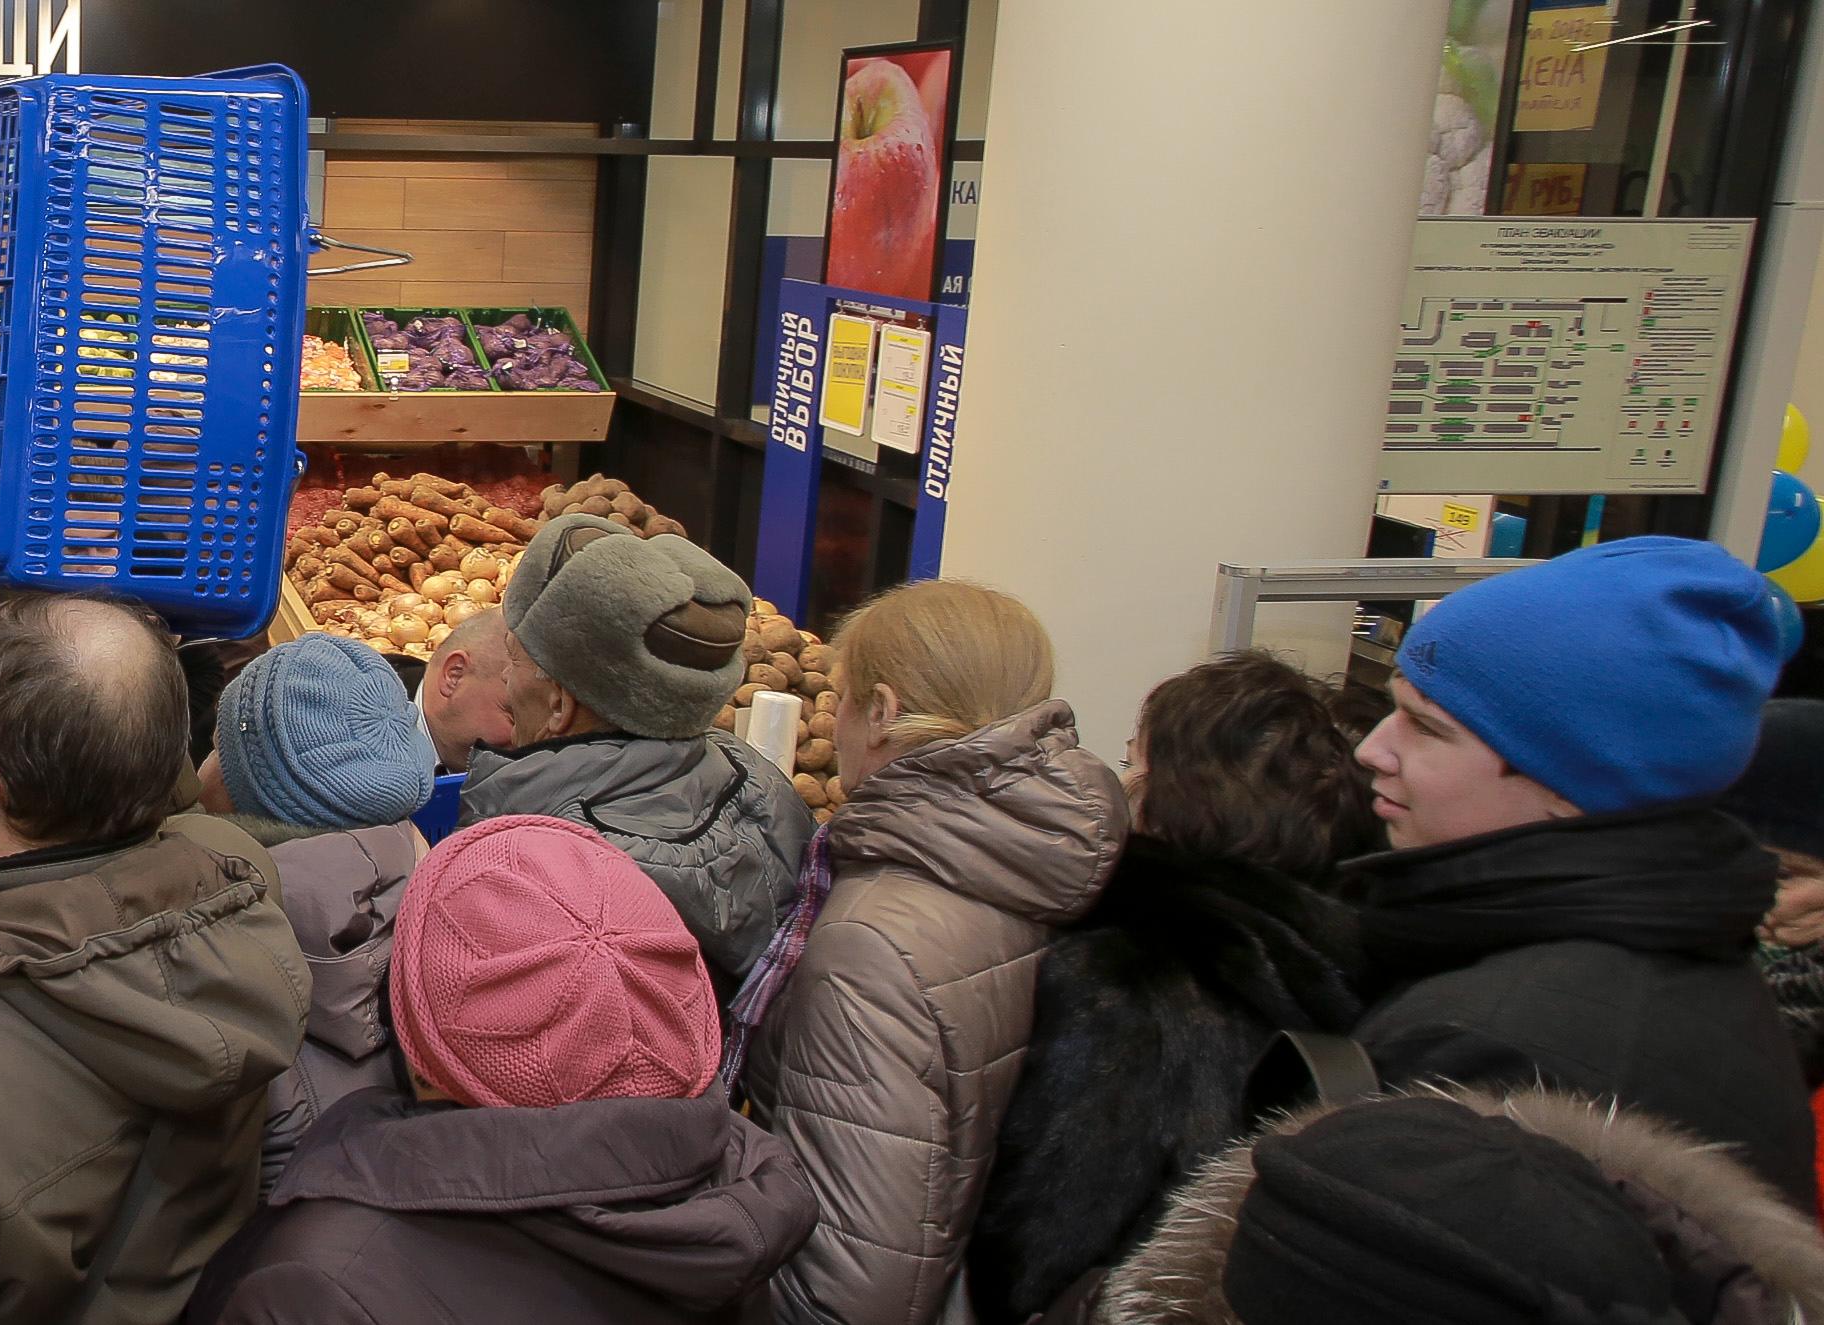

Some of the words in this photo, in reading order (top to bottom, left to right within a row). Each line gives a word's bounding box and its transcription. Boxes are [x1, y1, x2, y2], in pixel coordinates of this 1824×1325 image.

[771, 311, 799, 442] ОТЛИЧНЫЙ
[785, 317, 819, 452] ВЫБОР
[925, 343, 964, 499] ОТЛИЧНЫЙ
